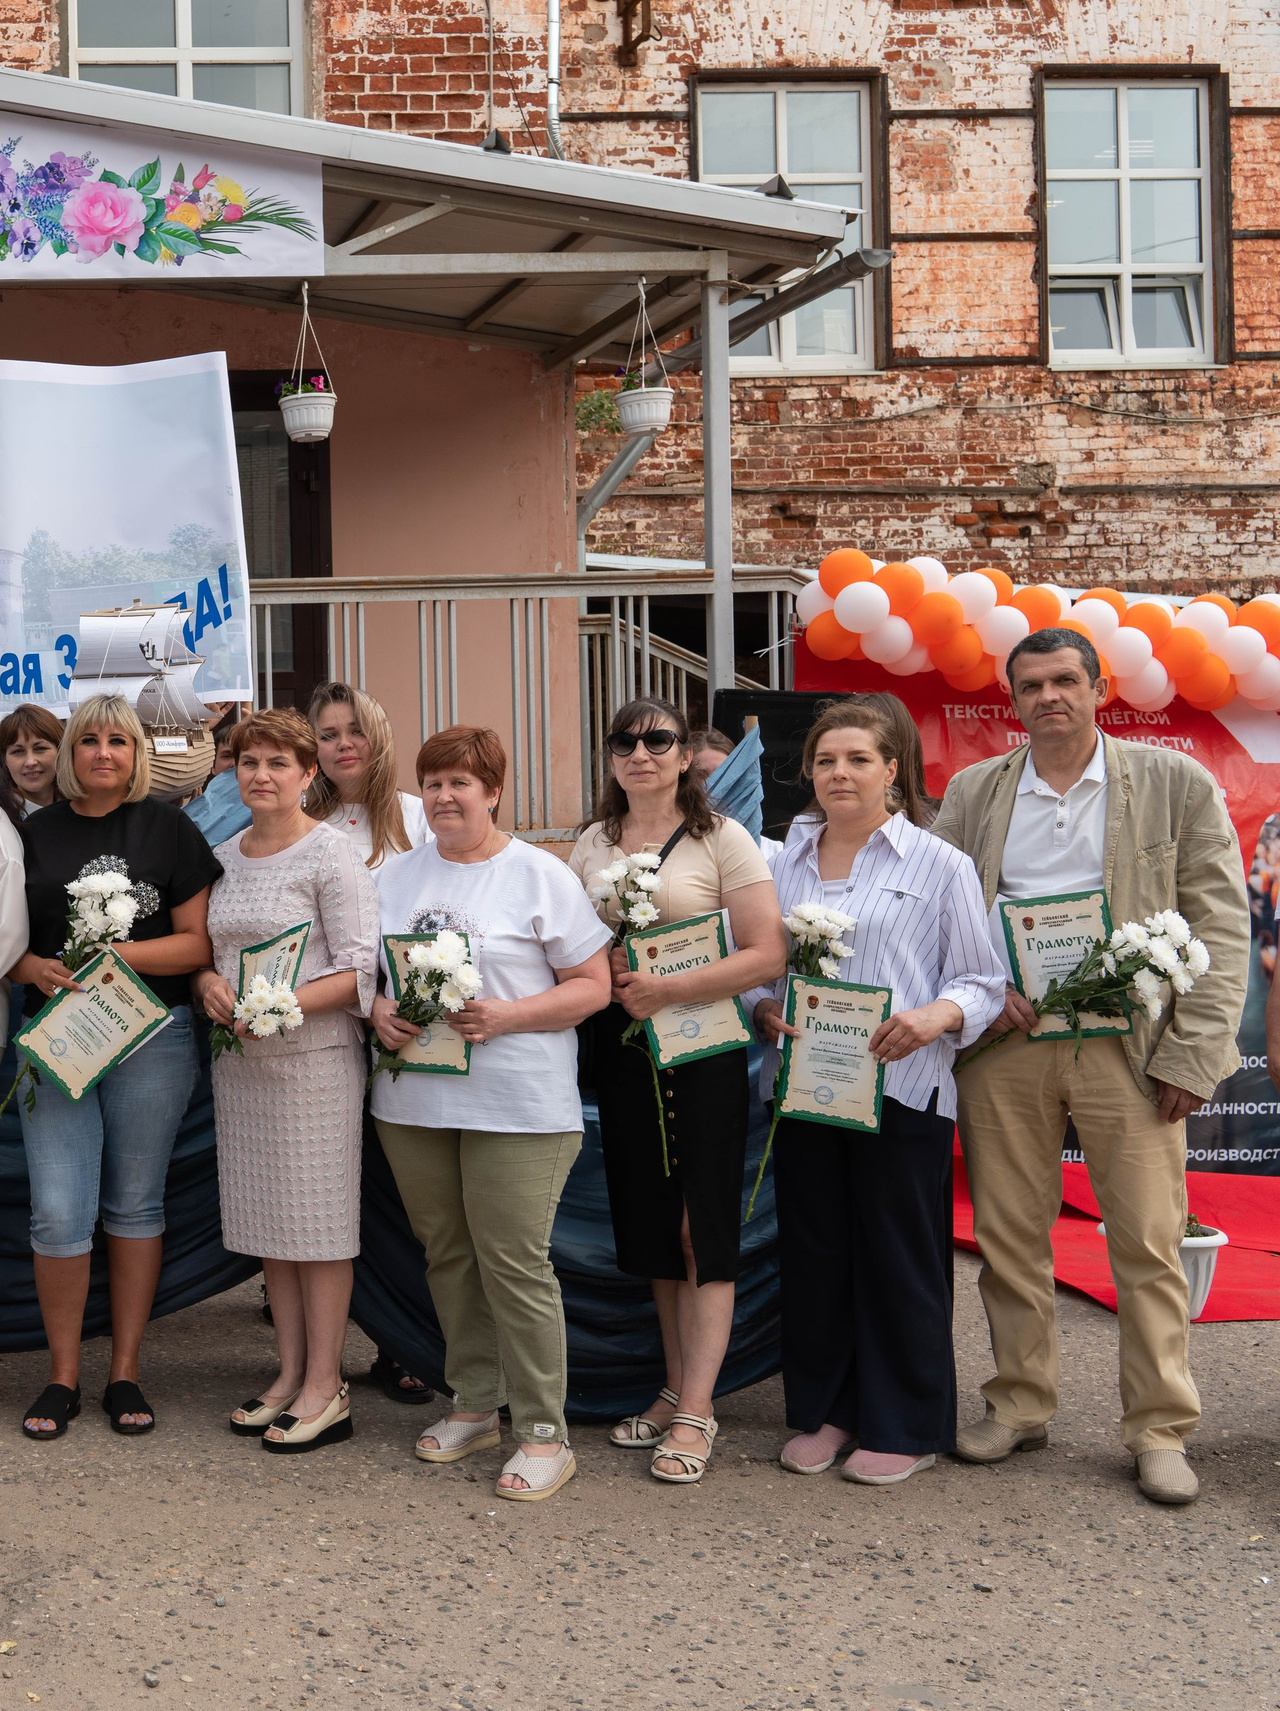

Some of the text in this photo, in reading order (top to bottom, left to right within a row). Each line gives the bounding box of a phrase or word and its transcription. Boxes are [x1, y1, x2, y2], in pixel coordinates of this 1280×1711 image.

[942, 704, 1171, 725] ТЕКСТИ ЛЁГКОЙ
[1025, 935, 1094, 954] Грамота
[649, 955, 711, 976] Грамота
[86, 984, 129, 1033] Грамота
[804, 1015, 869, 1038] Грамота
